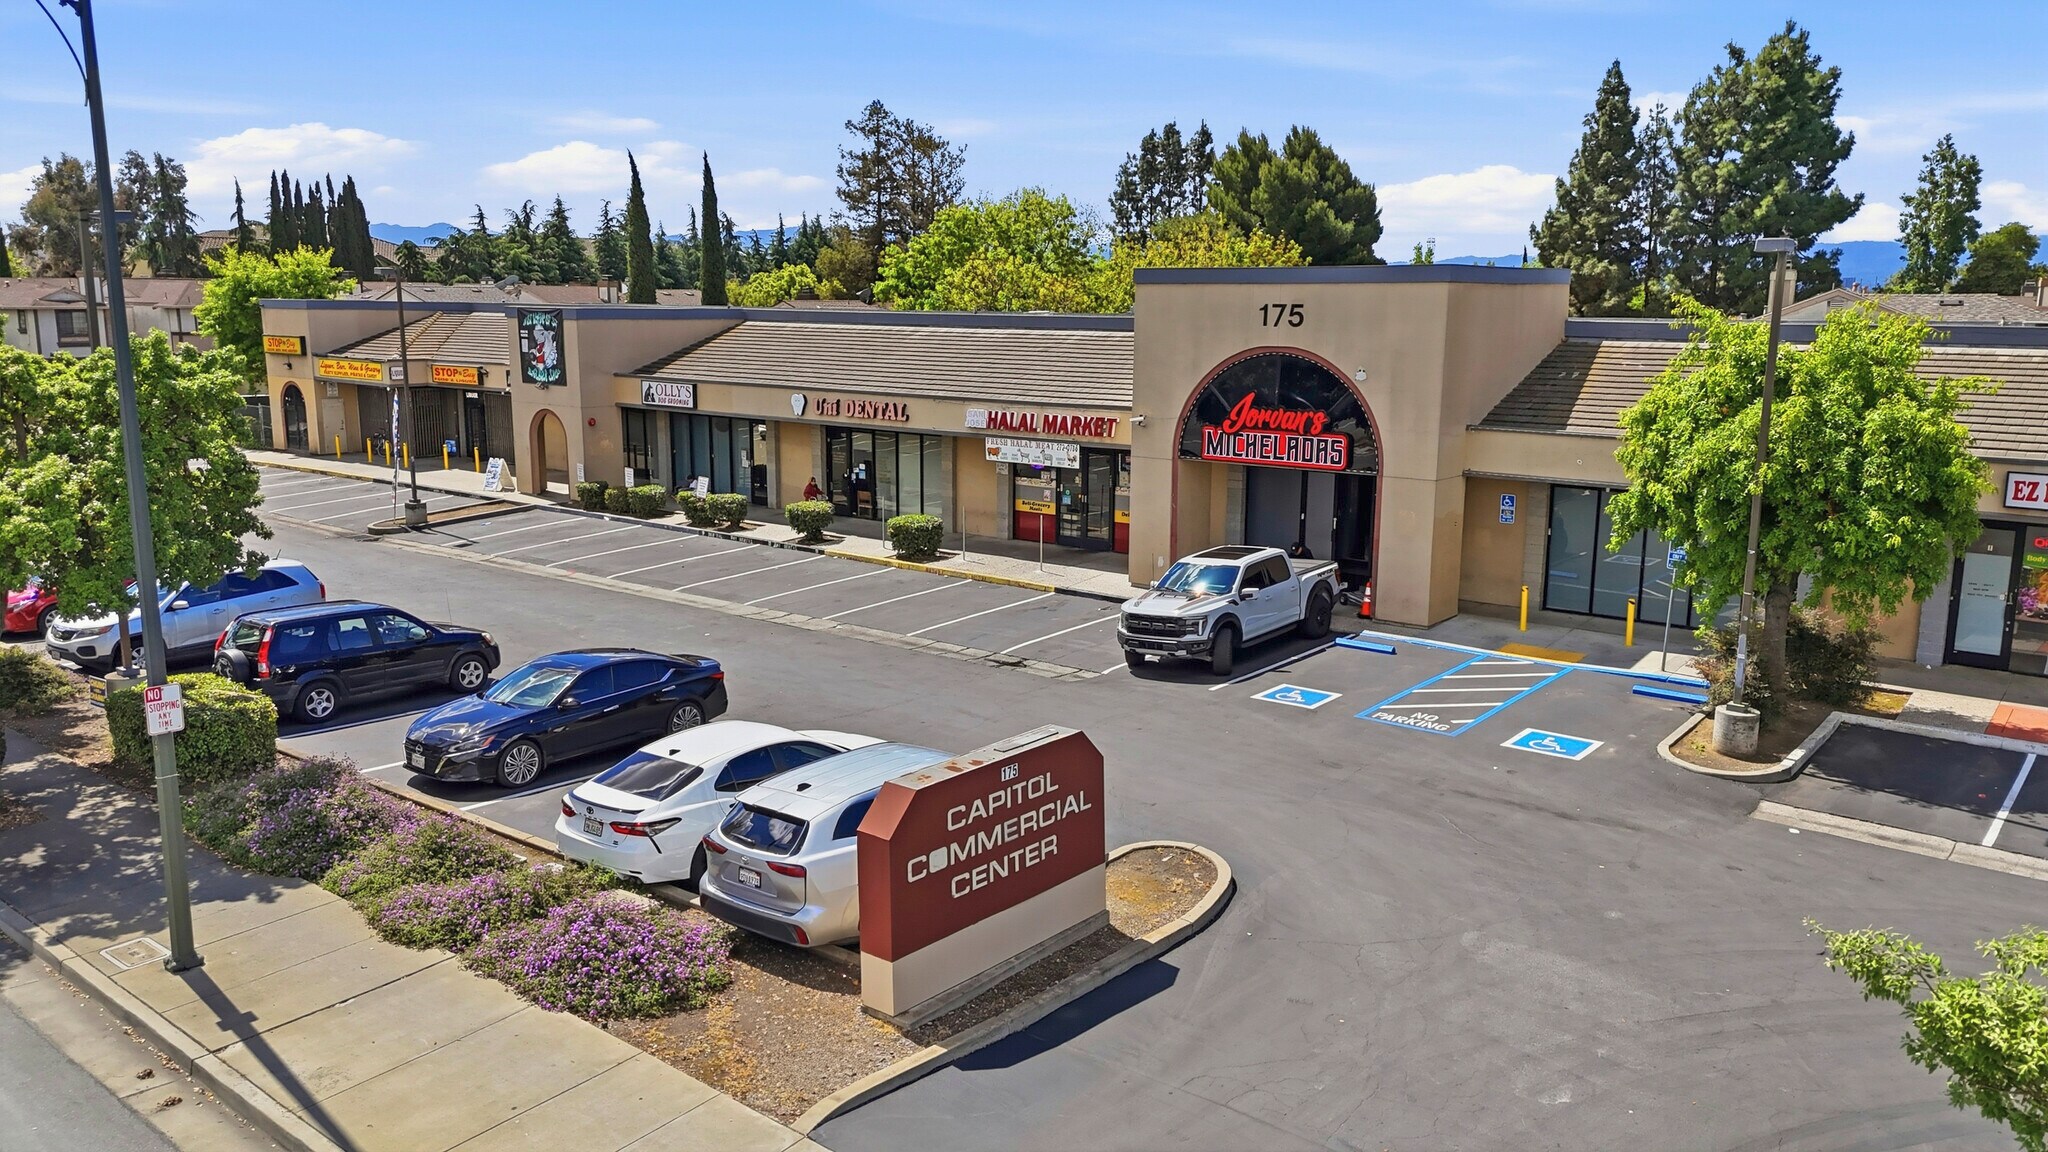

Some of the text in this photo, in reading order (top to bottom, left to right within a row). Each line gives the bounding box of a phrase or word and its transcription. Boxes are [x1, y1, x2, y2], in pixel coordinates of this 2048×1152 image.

[1258, 303, 1304, 328] 175
[267, 337, 282, 347] STOP
[434, 367, 459, 377] STOP
[655, 383, 692, 399] OLLY'S
[813, 398, 909, 421] Uni DENTAL
[967, 410, 985, 419] SAN
[1222, 390, 1329, 435] Jorvan's
[966, 419, 986, 427] JOSE
[987, 410, 1119, 438] HALAL MARKET
[986, 437, 1008, 447] FRESH
[1010, 440, 1033, 449] HALAL
[1035, 441, 1055, 450] MEAT
[1203, 429, 1344, 466] MICHELADAS
[2012, 480, 2040, 502] EZ
[2026, 554, 2046, 563] Body
[147, 688, 160, 701] NO
[149, 700, 180, 713] STOPPING
[158, 711, 171, 720] ANY
[158, 719, 173, 728] TIME
[1372, 711, 1450, 731] PARKING
[1410, 711, 1439, 722] NO
[1002, 764, 1018, 781] 175
[947, 772, 1059, 831] CAPITOL
[907, 790, 1092, 883] COMMERCIAL
[951, 835, 1058, 899] CENTER
